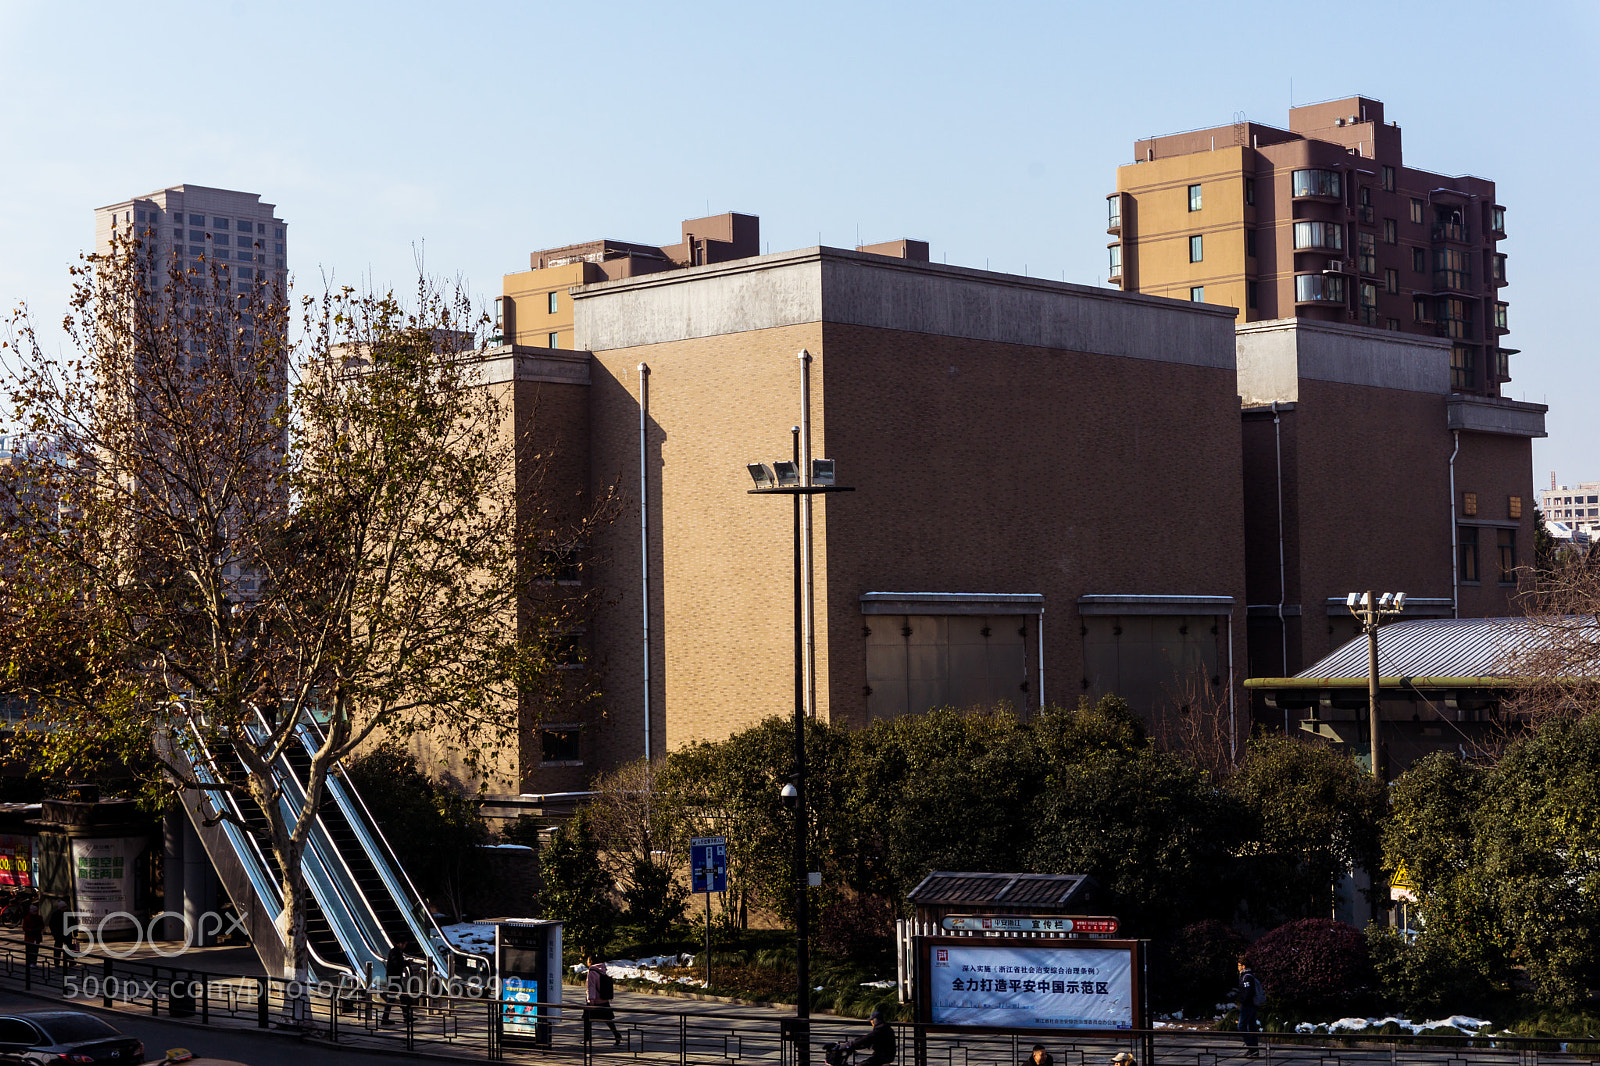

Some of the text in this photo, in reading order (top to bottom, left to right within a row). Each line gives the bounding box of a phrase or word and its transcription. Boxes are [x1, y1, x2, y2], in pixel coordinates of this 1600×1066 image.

[951, 977, 1109, 995] 全力打造平安中国示范区
